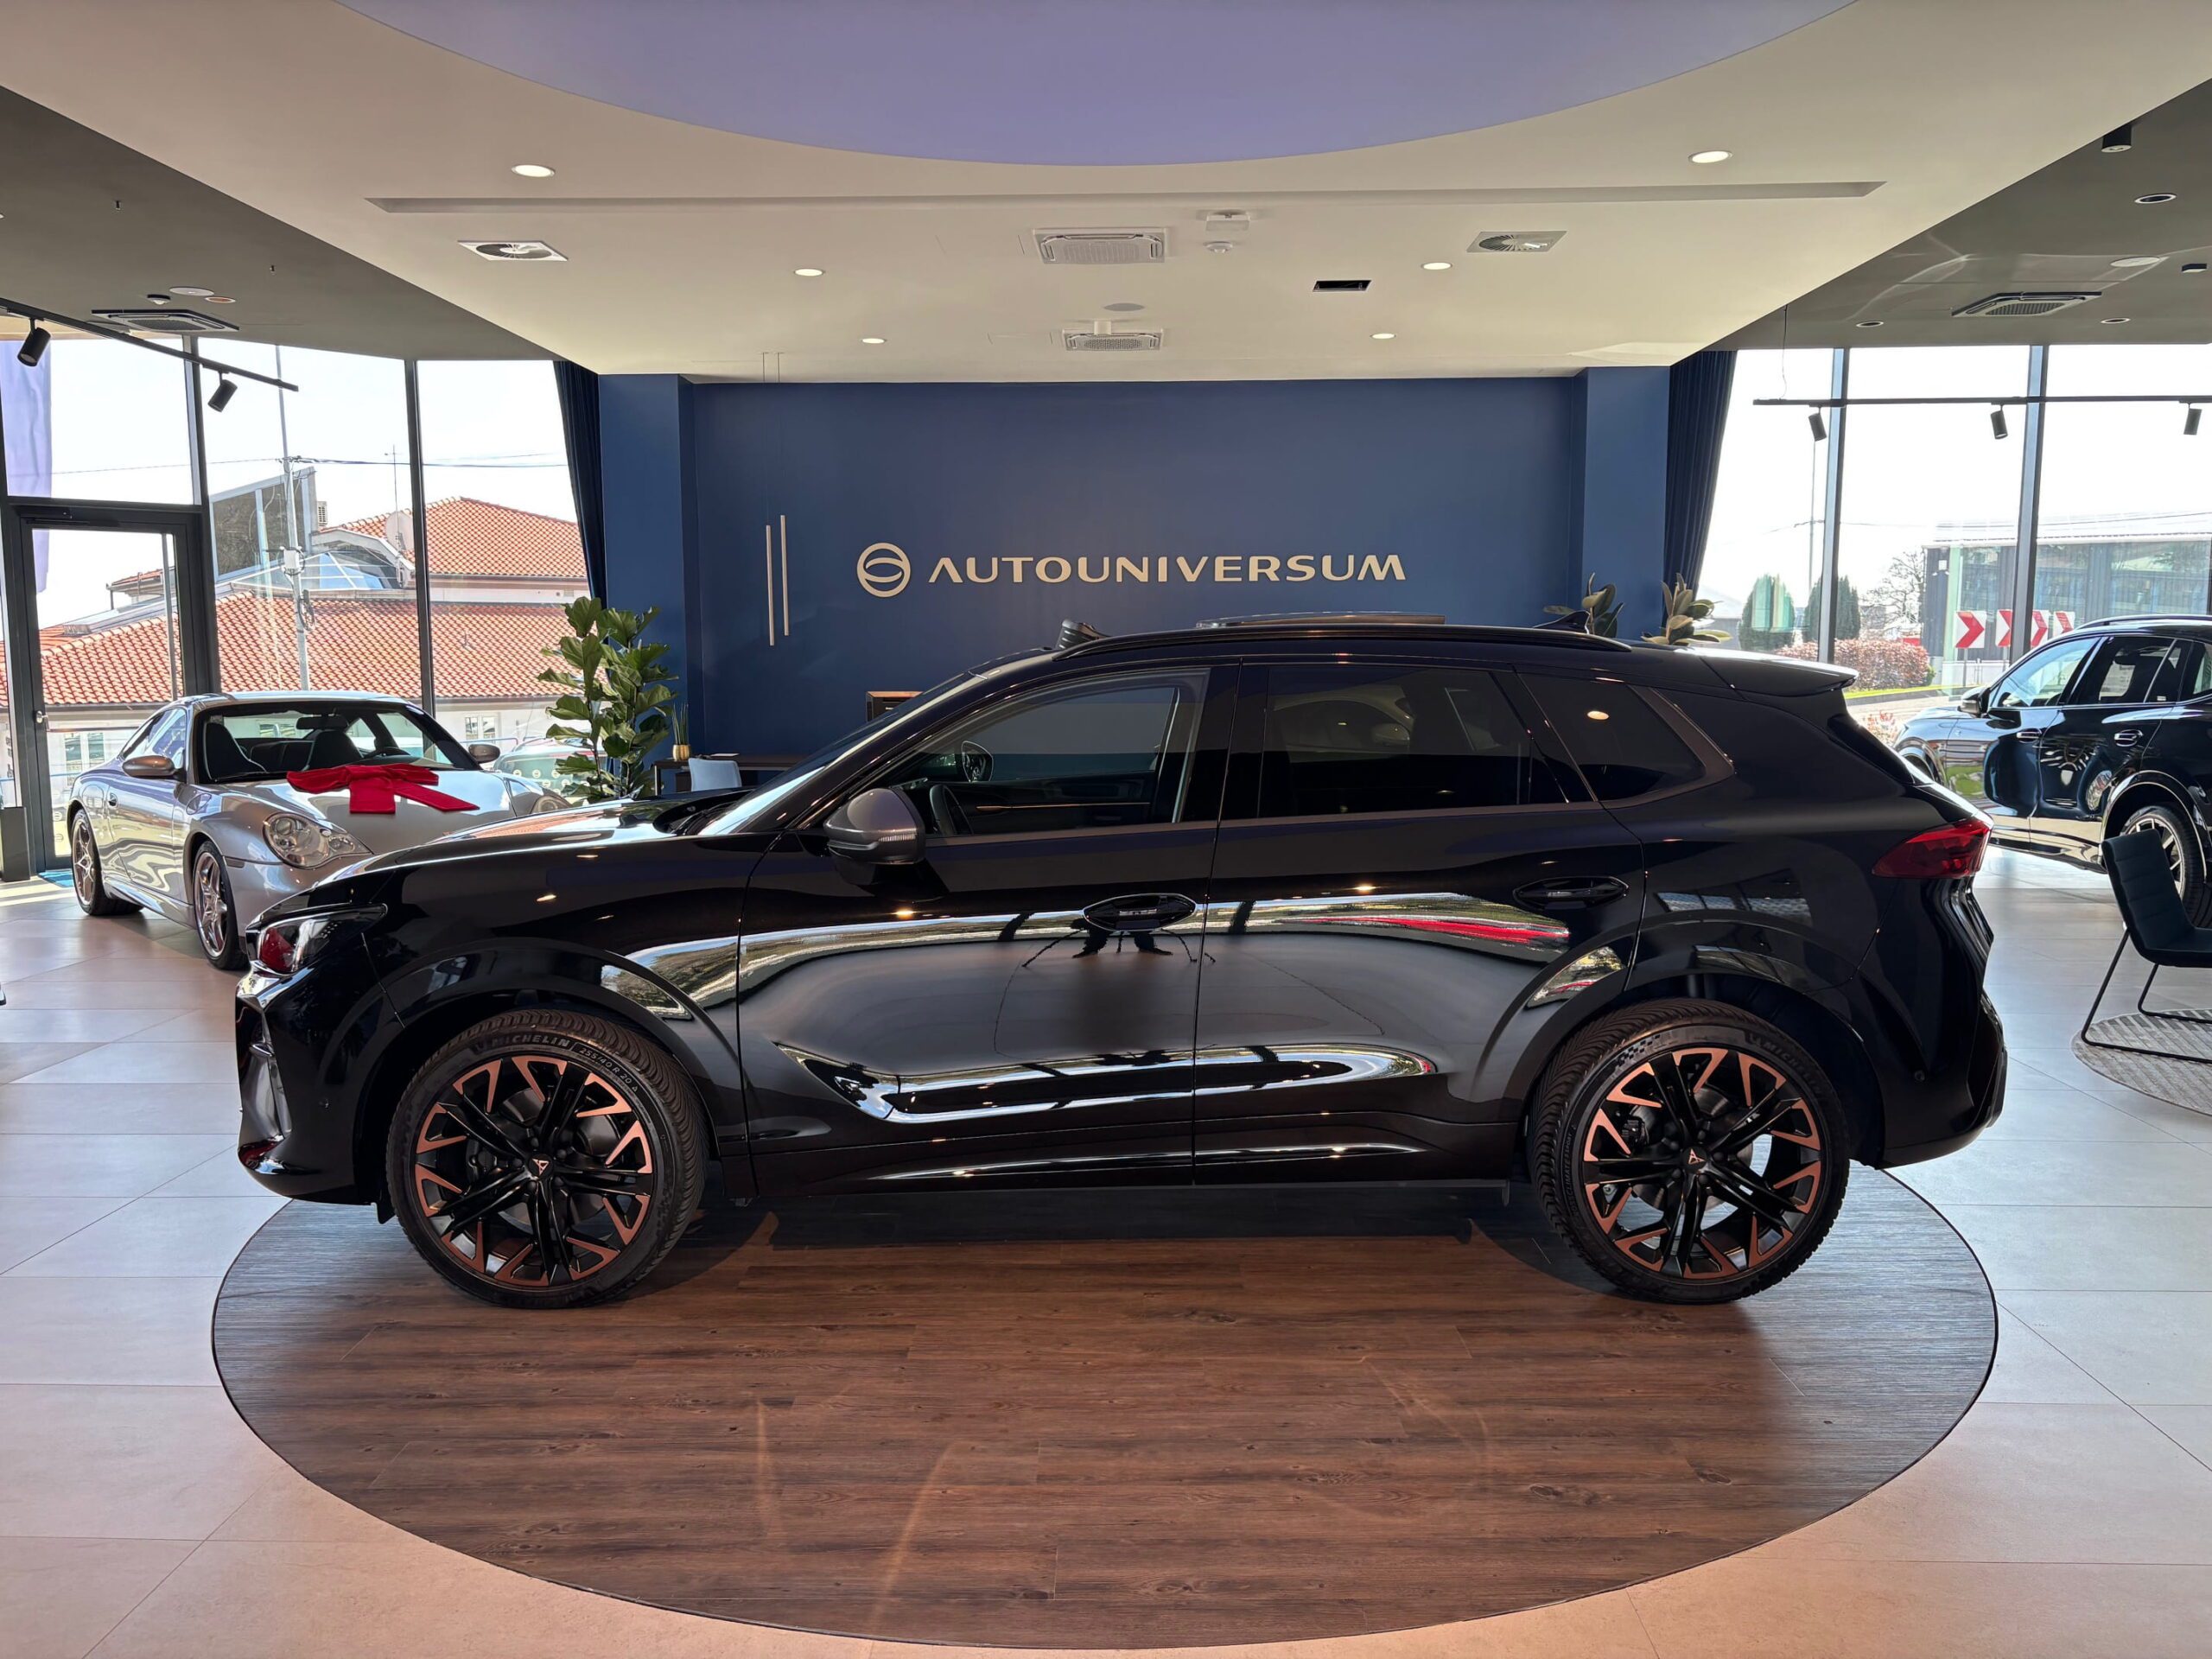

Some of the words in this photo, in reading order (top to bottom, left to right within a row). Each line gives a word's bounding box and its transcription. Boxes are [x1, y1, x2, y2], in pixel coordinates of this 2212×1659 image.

[928, 554, 1407, 583] AUTOUNIVERSUM
[579, 1047, 613, 1069] 255/40
[620, 1073, 632, 1084] 20
